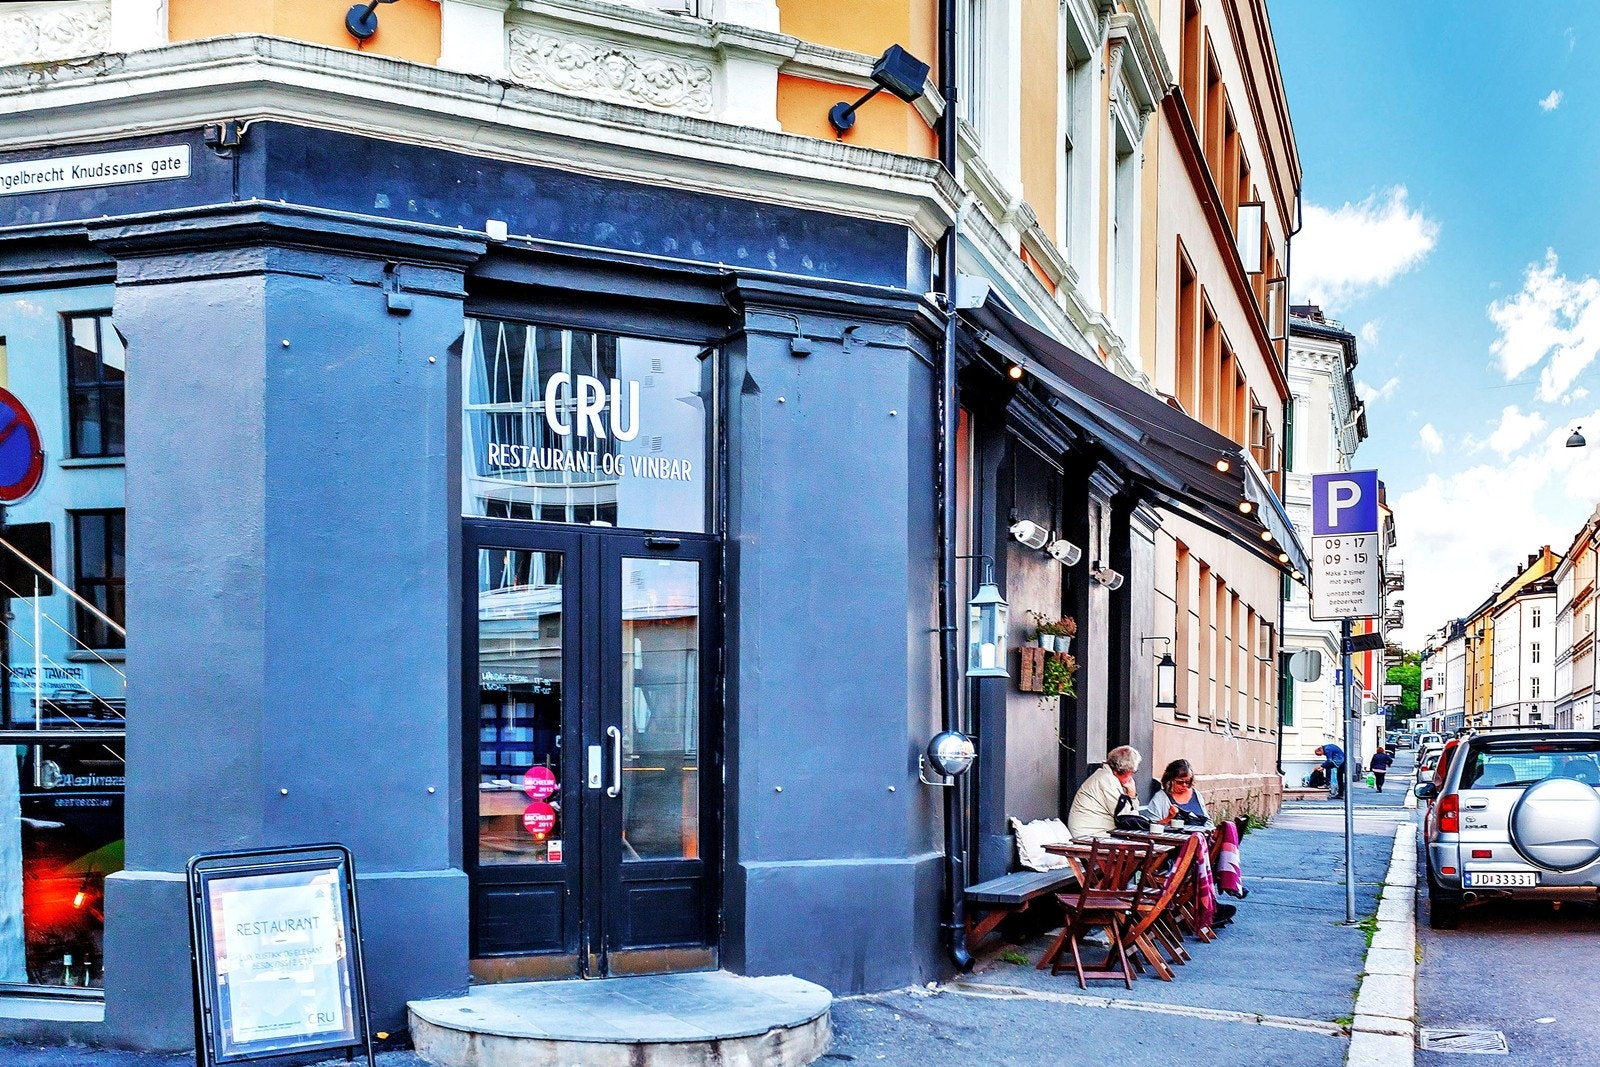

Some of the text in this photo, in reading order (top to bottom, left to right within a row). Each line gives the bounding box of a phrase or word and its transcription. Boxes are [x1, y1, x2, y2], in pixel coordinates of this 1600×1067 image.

[71, 161, 143, 180] Knudssøns
[151, 156, 181, 175] gate
[545, 371, 640, 442] CRU
[488, 442, 692, 481] RESTAURANT OG VINBAR
[1327, 480, 1362, 527] P
[1325, 539, 1341, 550] 09
[1353, 538, 1365, 548] 17
[1323, 554, 1341, 567] (09
[1353, 552, 1368, 564] 15)
[1343, 578, 1362, 586] avgift
[1474, 874, 1489, 885] JD
[1495, 874, 1531, 885] 33331
[236, 916, 319, 936] RESTAURANT
[307, 1012, 335, 1025] CRU
